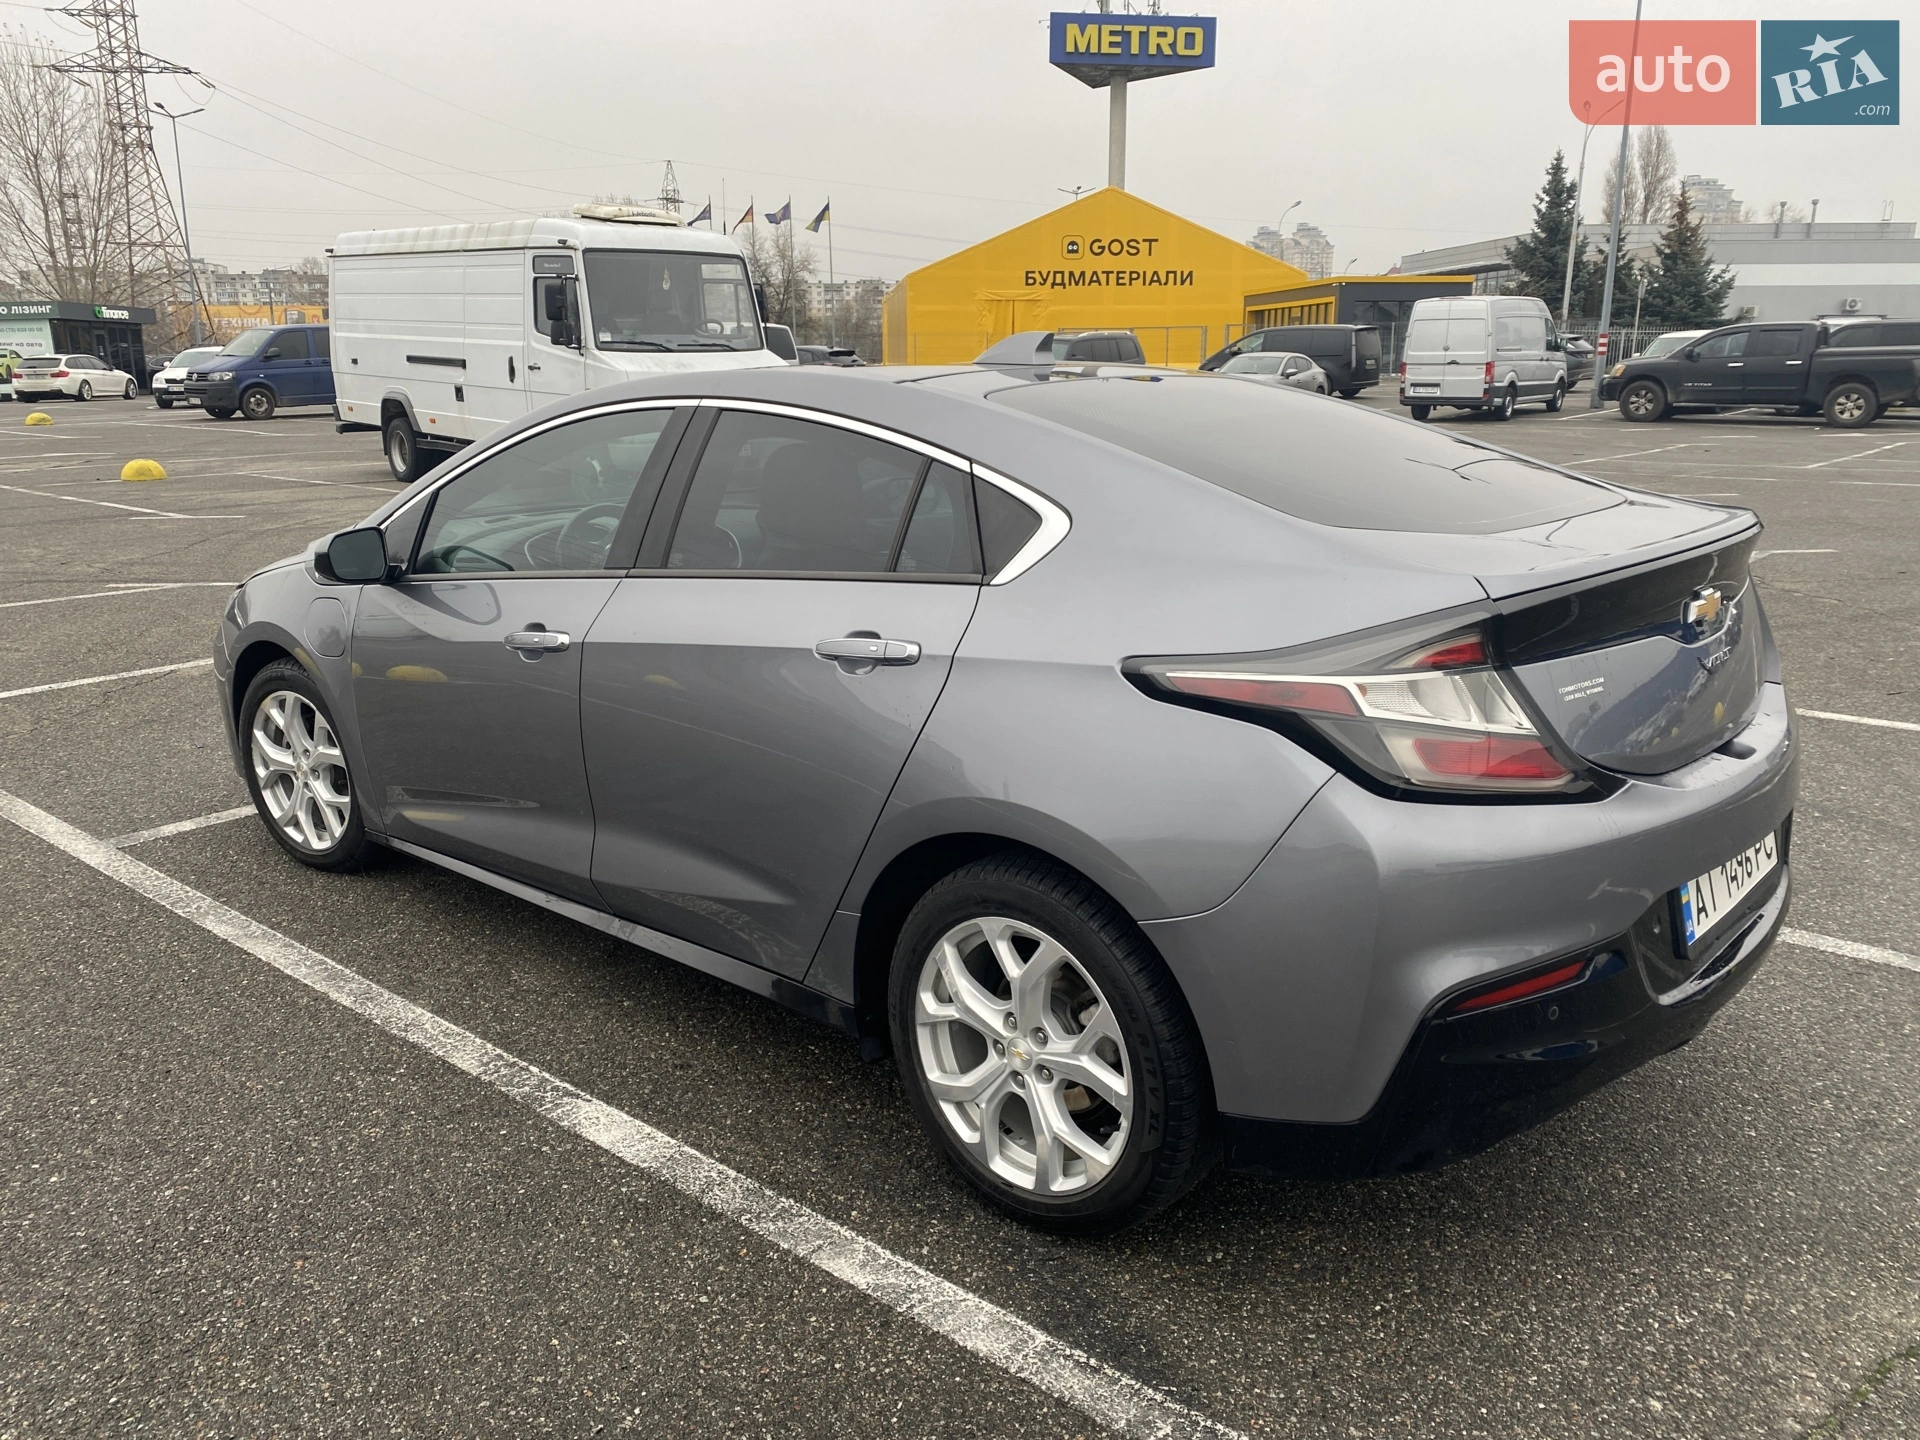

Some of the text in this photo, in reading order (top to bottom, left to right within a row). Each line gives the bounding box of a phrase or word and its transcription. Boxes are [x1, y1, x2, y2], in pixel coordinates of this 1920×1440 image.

[1066, 23, 1204, 56] METRO
[1089, 238, 1159, 257] GOST
[1024, 270, 1194, 289] БУДМАТЕРІАЛИ
[11, 305, 52, 314] ЛІЗИНГ
[1721, 851, 1753, 899] 1496
